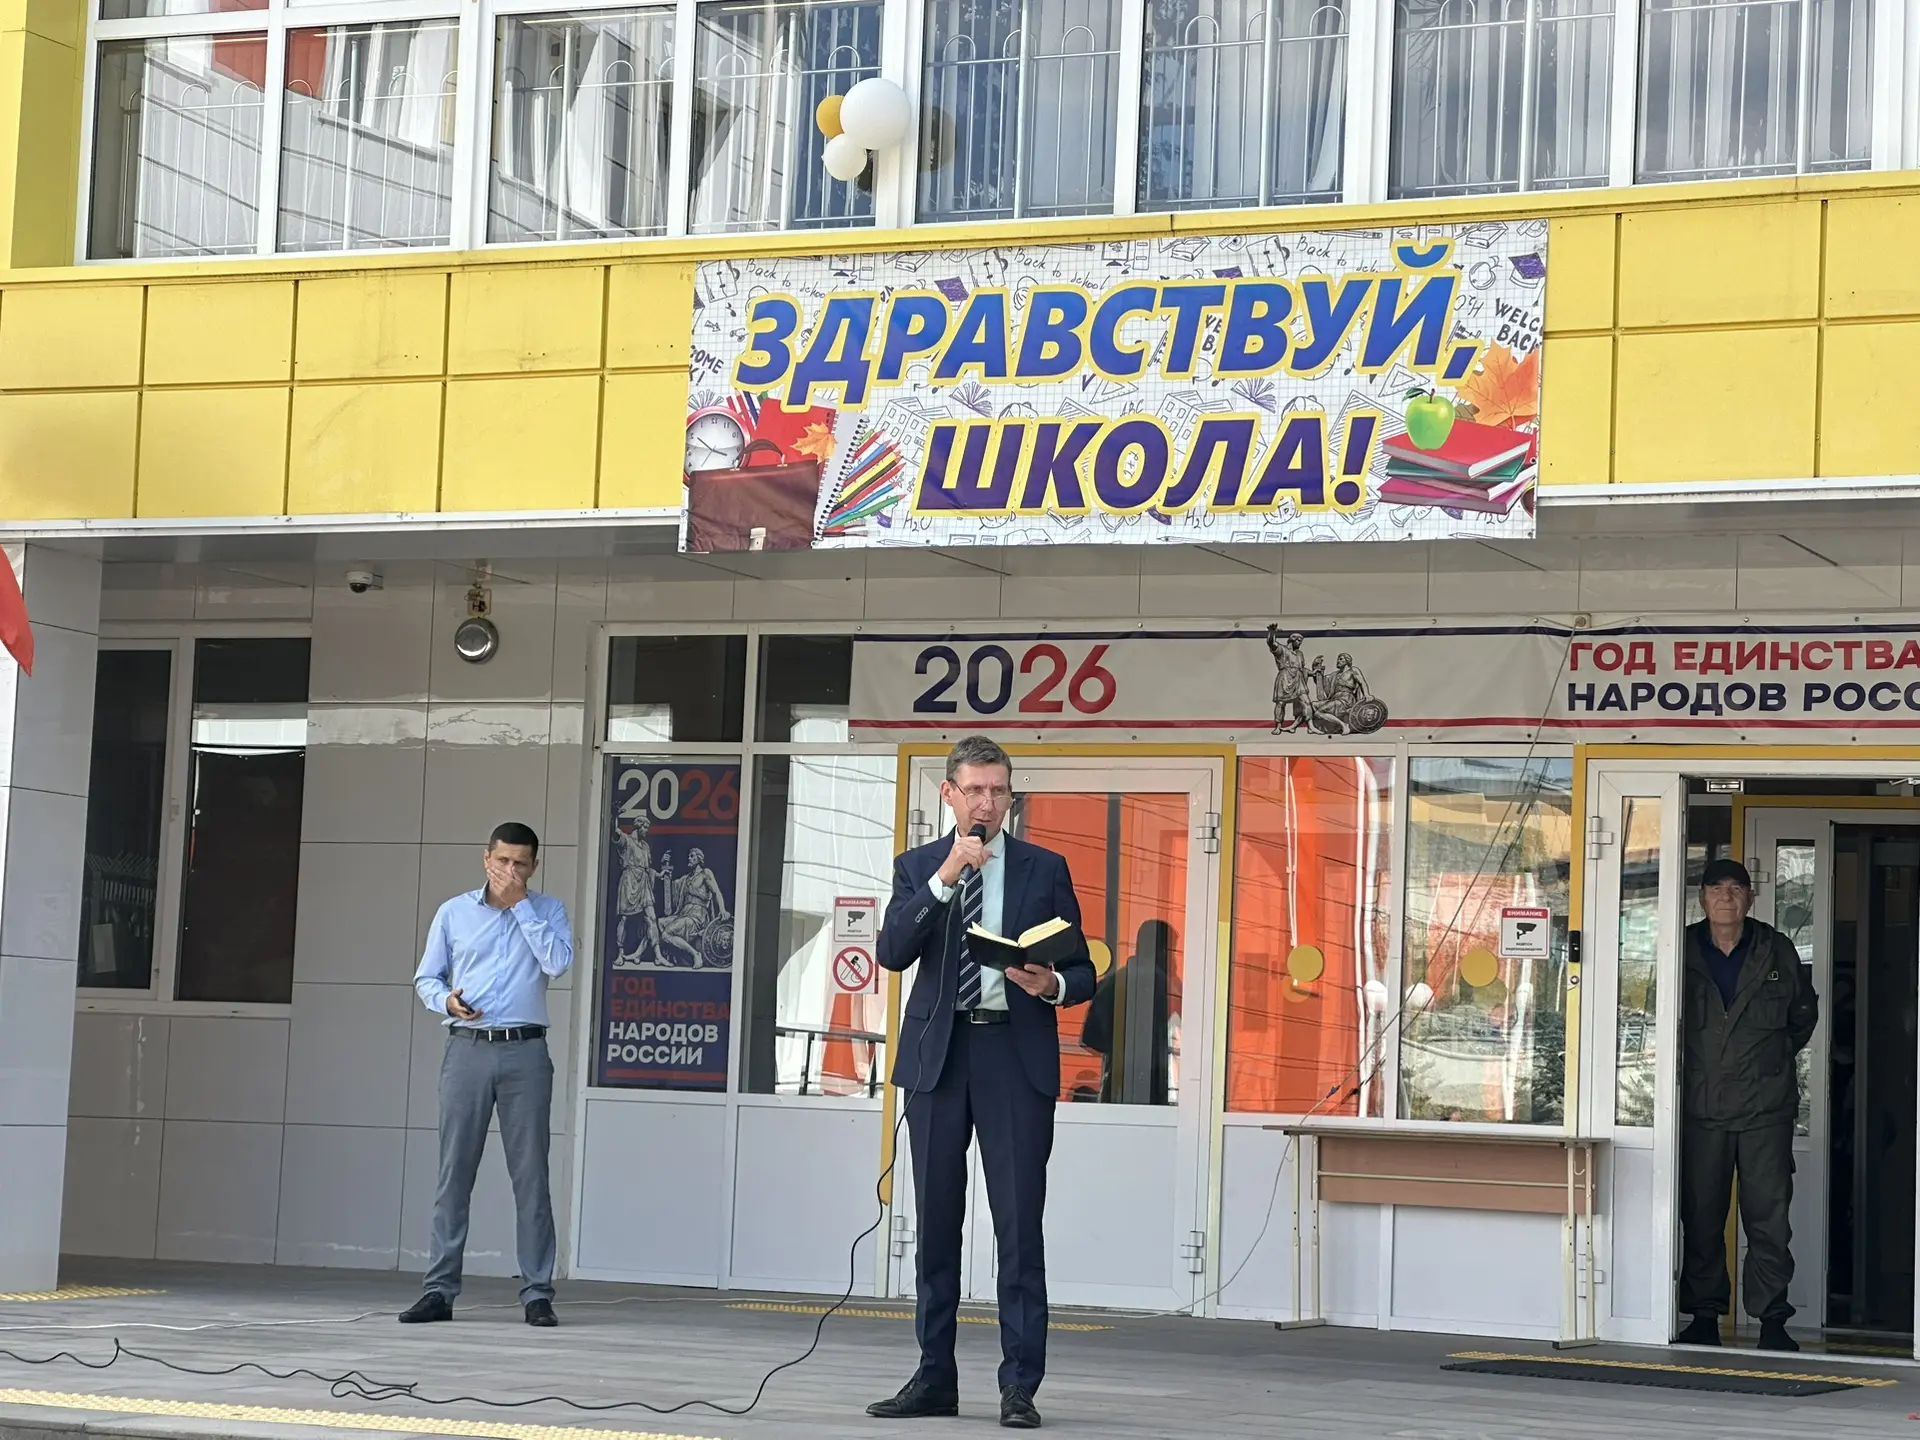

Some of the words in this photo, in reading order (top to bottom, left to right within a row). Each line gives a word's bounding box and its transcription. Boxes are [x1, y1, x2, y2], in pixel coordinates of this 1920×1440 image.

[1014, 247, 1050, 269] Back
[1052, 262, 1062, 278] to
[1296, 234, 1334, 258] Back
[1337, 251, 1347, 266] to
[746, 258, 780, 280] Back
[782, 272, 792, 288] to
[734, 242, 1480, 406] ЗДРАВСТВУЙ,
[915, 415, 1376, 510] ШКОЛА!
[1569, 640, 1657, 675] ГОД
[1673, 639, 1920, 675] ЕДИНСТВА
[912, 643, 1117, 715] 2026
[1567, 681, 1788, 717] НАРОДОВ
[617, 768, 739, 821] 2026
[611, 976, 656, 998] ГОД
[611, 998, 729, 1021] ЕДИНСТВА
[608, 1021, 719, 1046] НАРОДОВ
[606, 1043, 704, 1066] РОССИИ
